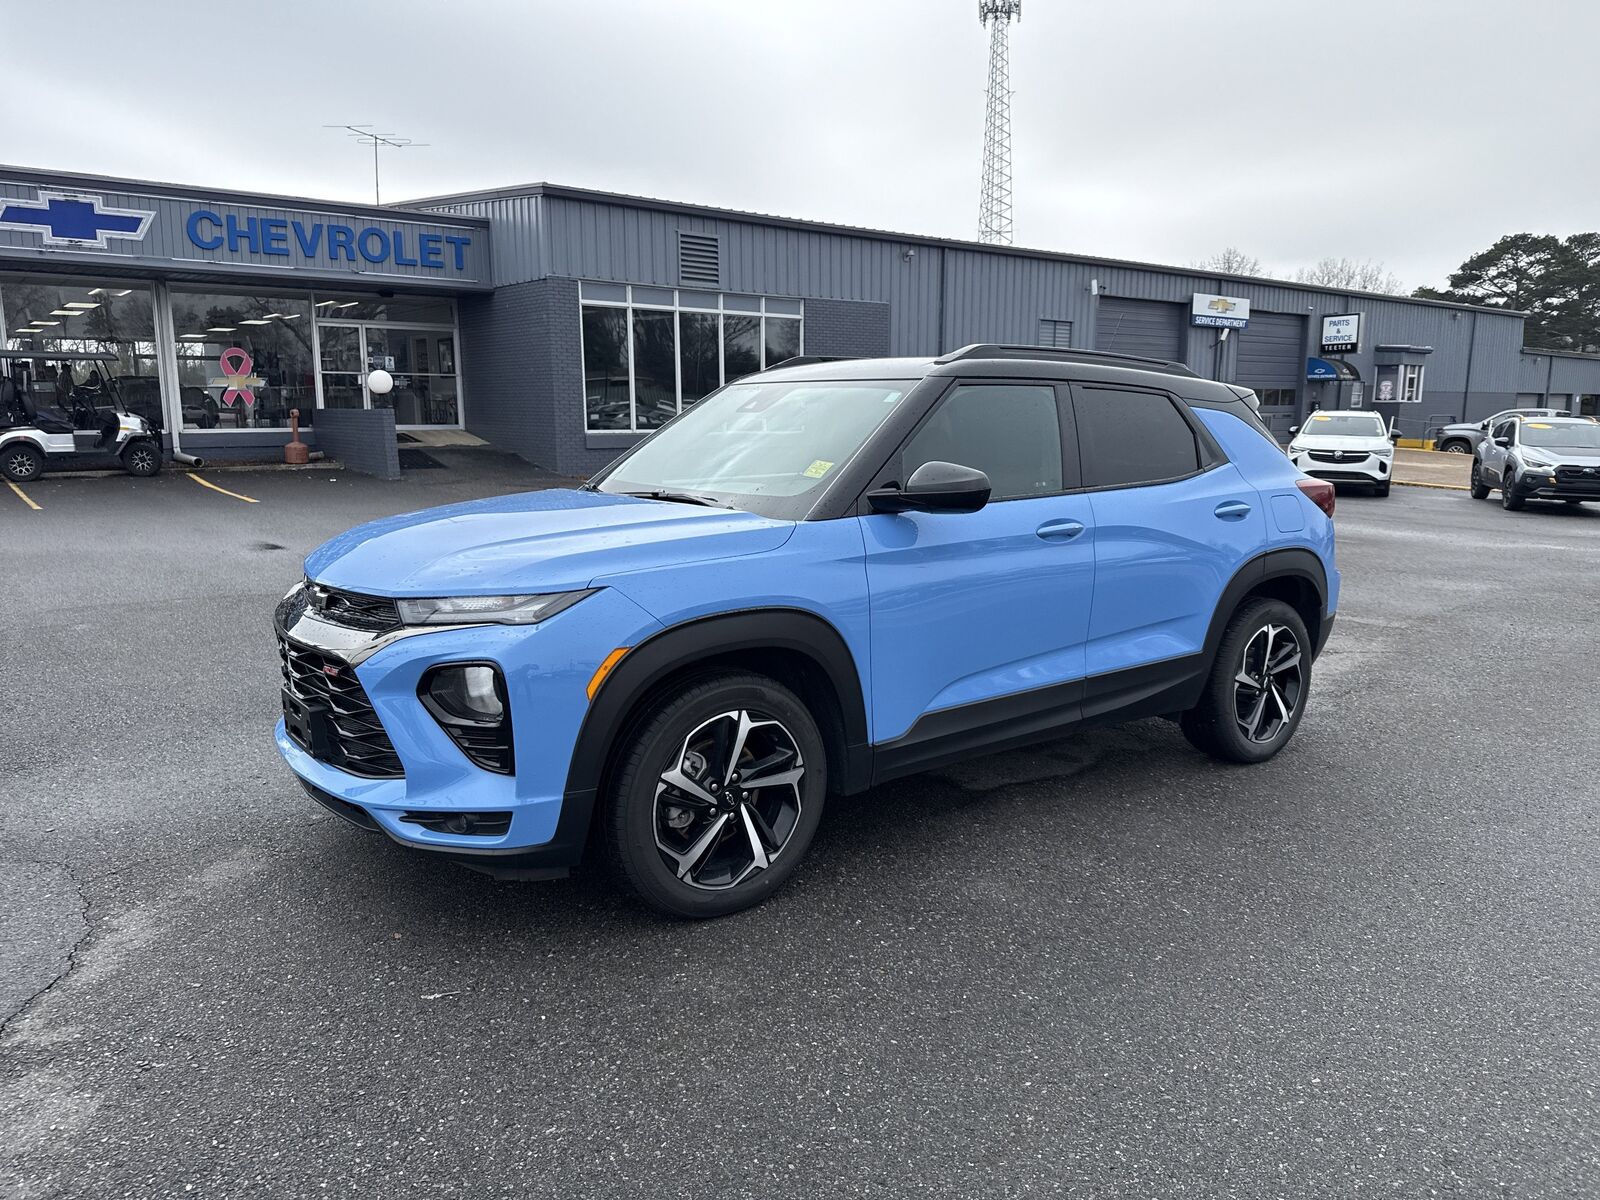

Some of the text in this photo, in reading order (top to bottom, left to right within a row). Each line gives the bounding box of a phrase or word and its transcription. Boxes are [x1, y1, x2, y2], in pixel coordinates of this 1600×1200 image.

[186, 210, 471, 270] CHEVROLET
[1195, 316, 1247, 328] SERVICE DEPARTMENT
[1328, 319, 1351, 327] PARTS
[1324, 334, 1353, 343] SERVICE
